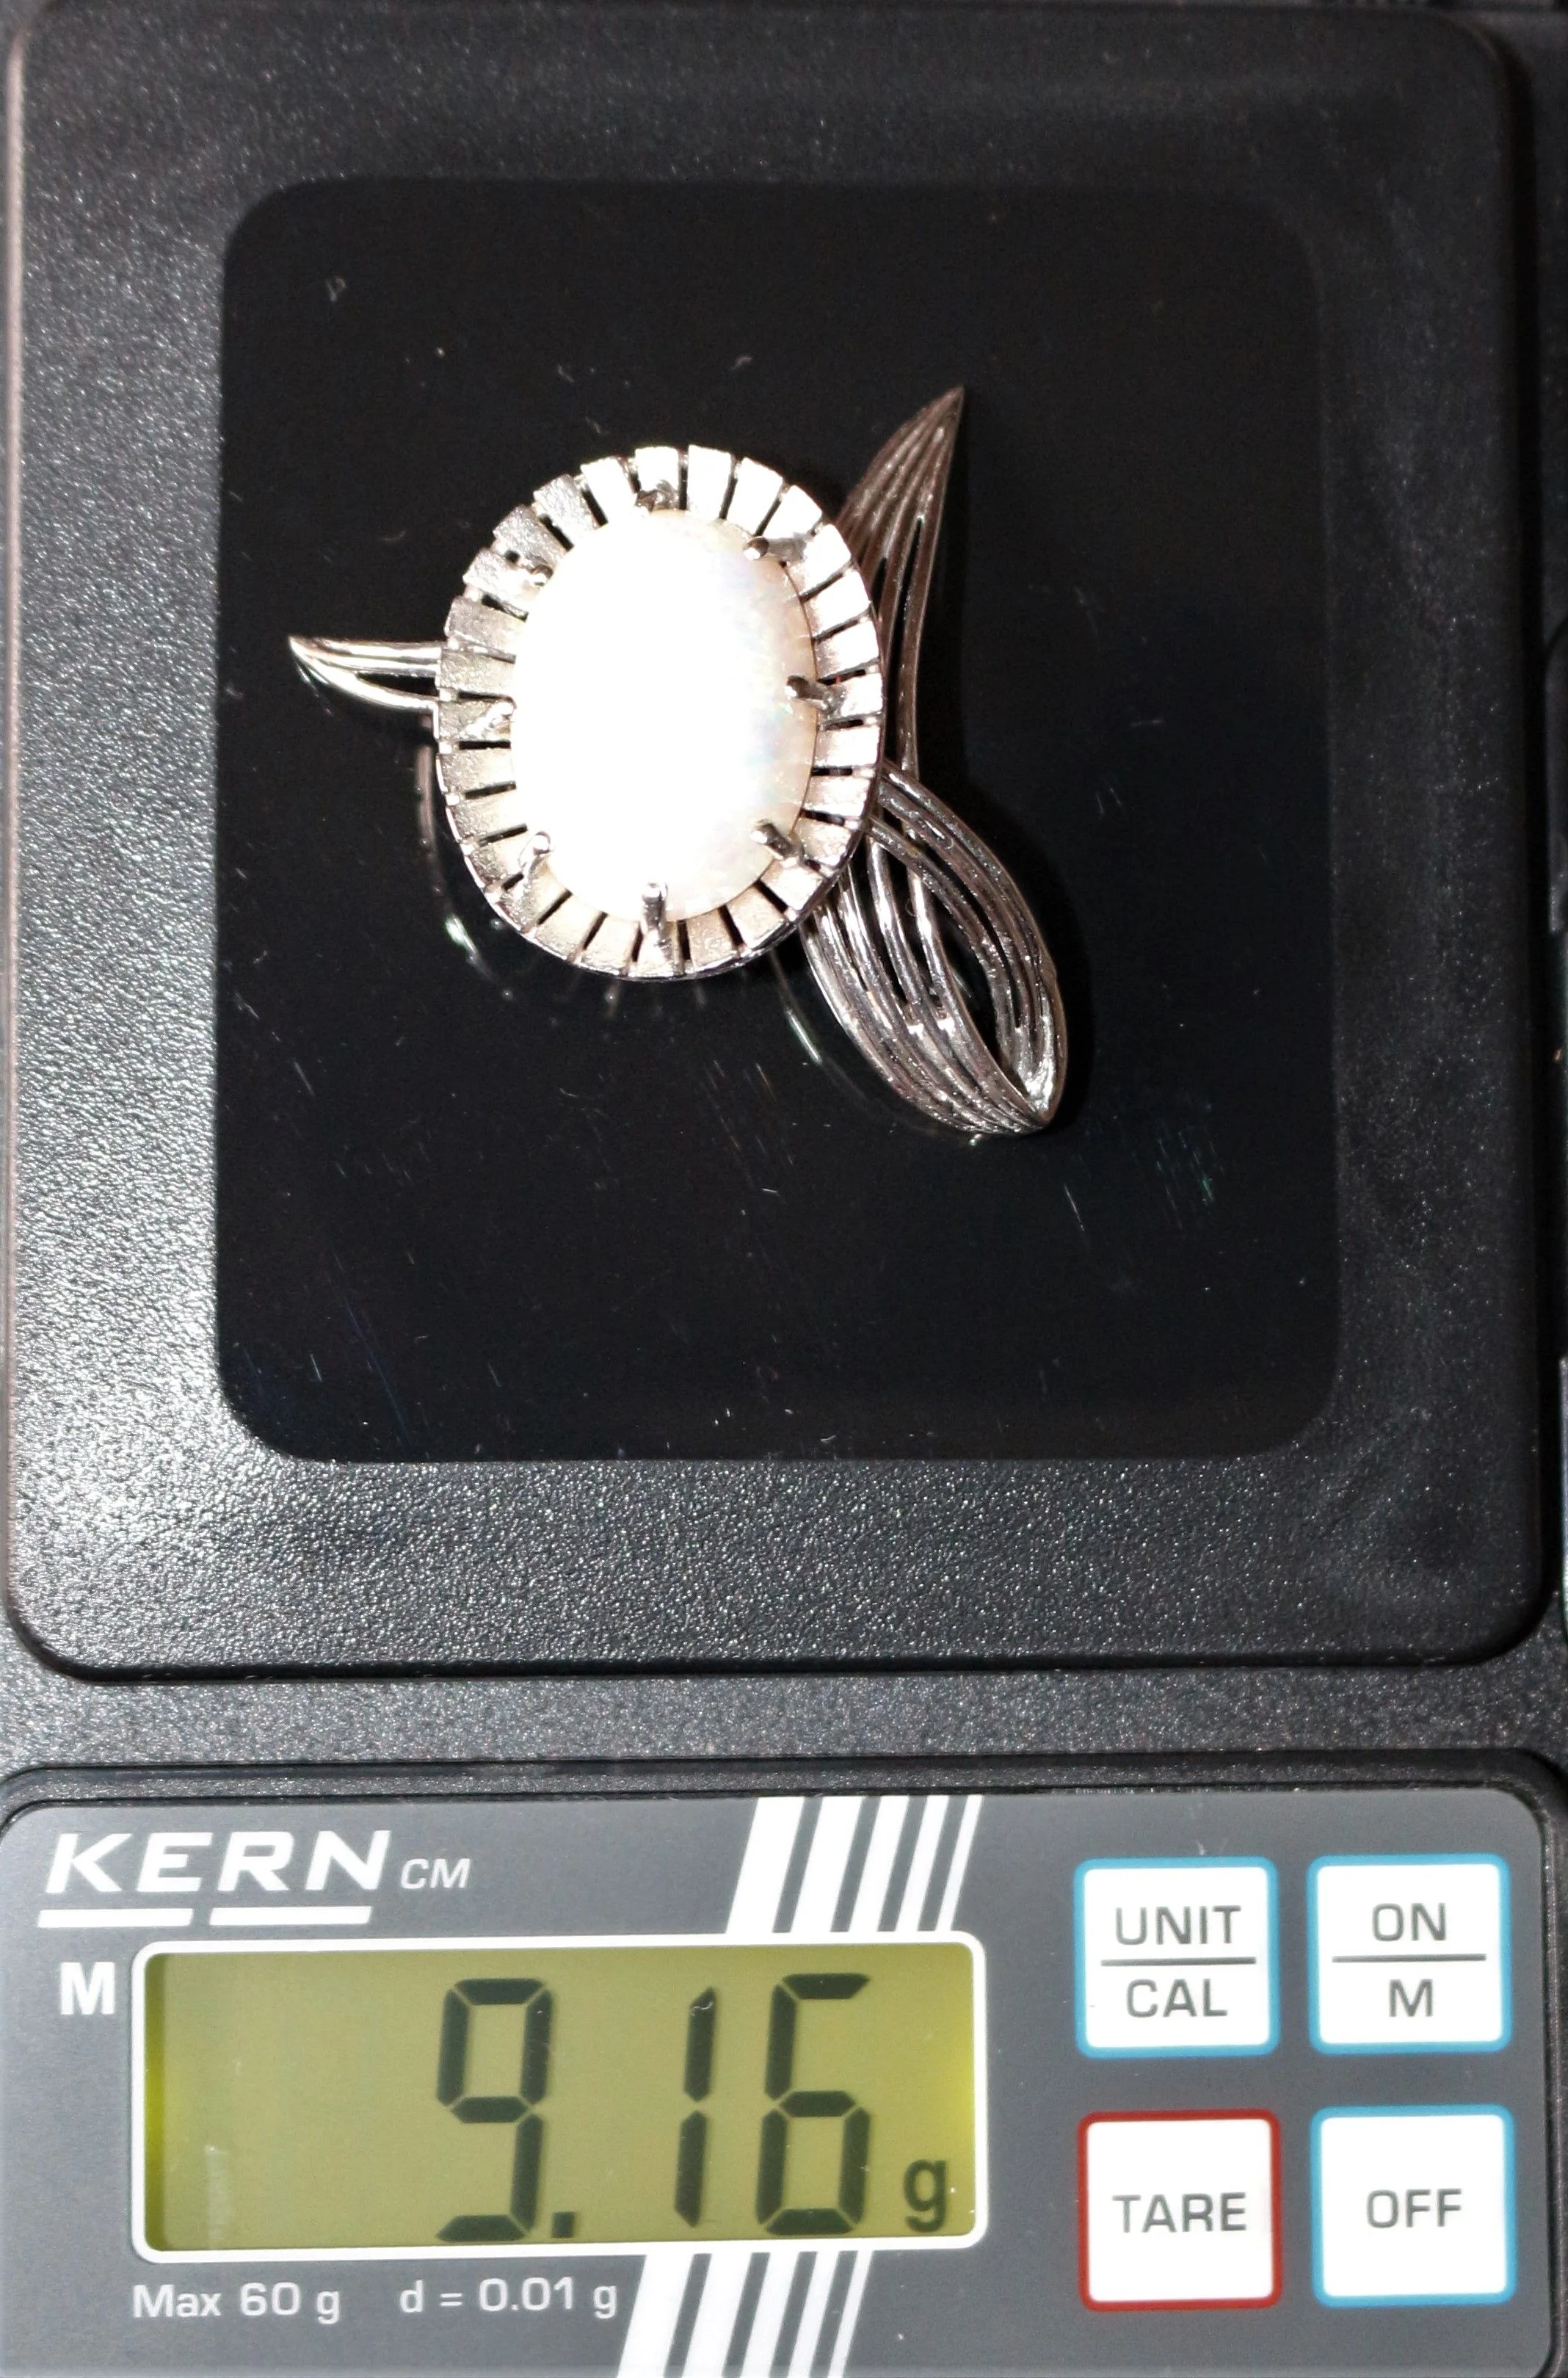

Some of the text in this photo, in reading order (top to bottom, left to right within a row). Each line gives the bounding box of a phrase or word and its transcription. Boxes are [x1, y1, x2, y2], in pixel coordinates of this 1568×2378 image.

[45, 1830, 471, 1894] KERN CM
[1114, 1904, 1242, 1946] UNIT
[1371, 1902, 1447, 1942] ON
[60, 1961, 117, 2016] M
[1125, 1978, 1228, 2018] CAL
[1388, 1978, 1434, 2018] M
[435, 1972, 949, 2242] 9.16 g
[1113, 2192, 1247, 2233] TARE
[1366, 2187, 1462, 2230] OFF
[132, 2281, 341, 2325] Max 60 g
[399, 2276, 618, 2320] d = 0.01 g
